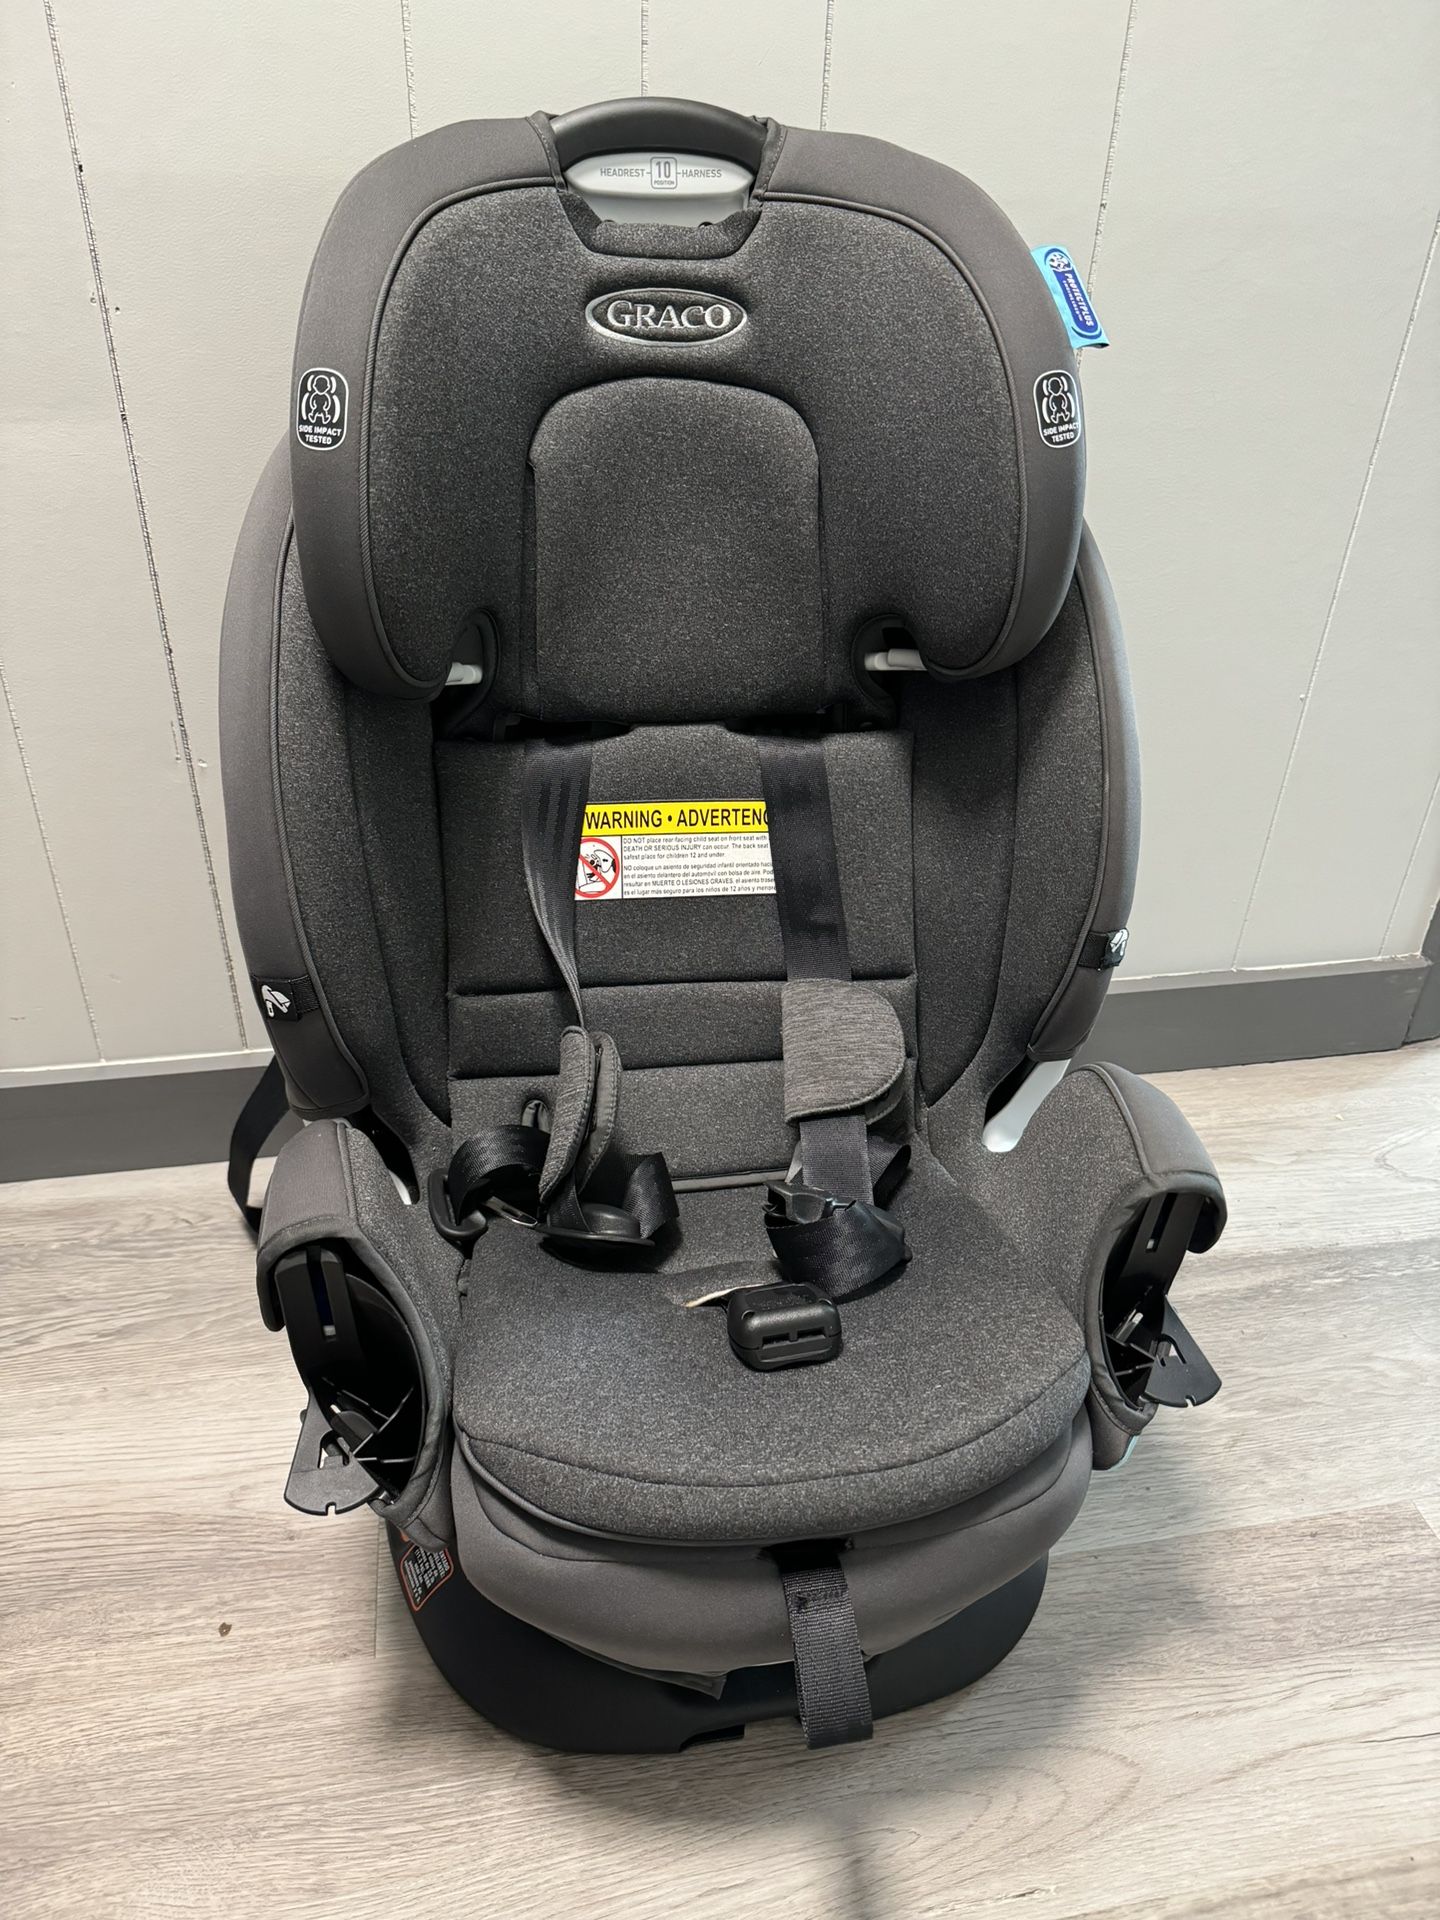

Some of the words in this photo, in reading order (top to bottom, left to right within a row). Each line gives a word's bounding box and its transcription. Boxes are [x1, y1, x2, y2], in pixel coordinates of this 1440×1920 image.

[600, 168, 646, 178] HEADREST
[655, 160, 672, 179] 10
[681, 168, 722, 179] HARNESS
[607, 300, 732, 329] GRACO
[298, 424, 313, 433] SIDE
[313, 426, 342, 437] IMPACT
[1042, 426, 1058, 437] SIDE
[1057, 421, 1080, 433] IMPACT
[305, 434, 332, 445] TESTED
[1051, 431, 1075, 443] TESTED
[585, 810, 662, 829] WARNING
[647, 836, 661, 844] place
[691, 862, 716, 870] seguridad
[682, 878, 708, 886] LESIONES
